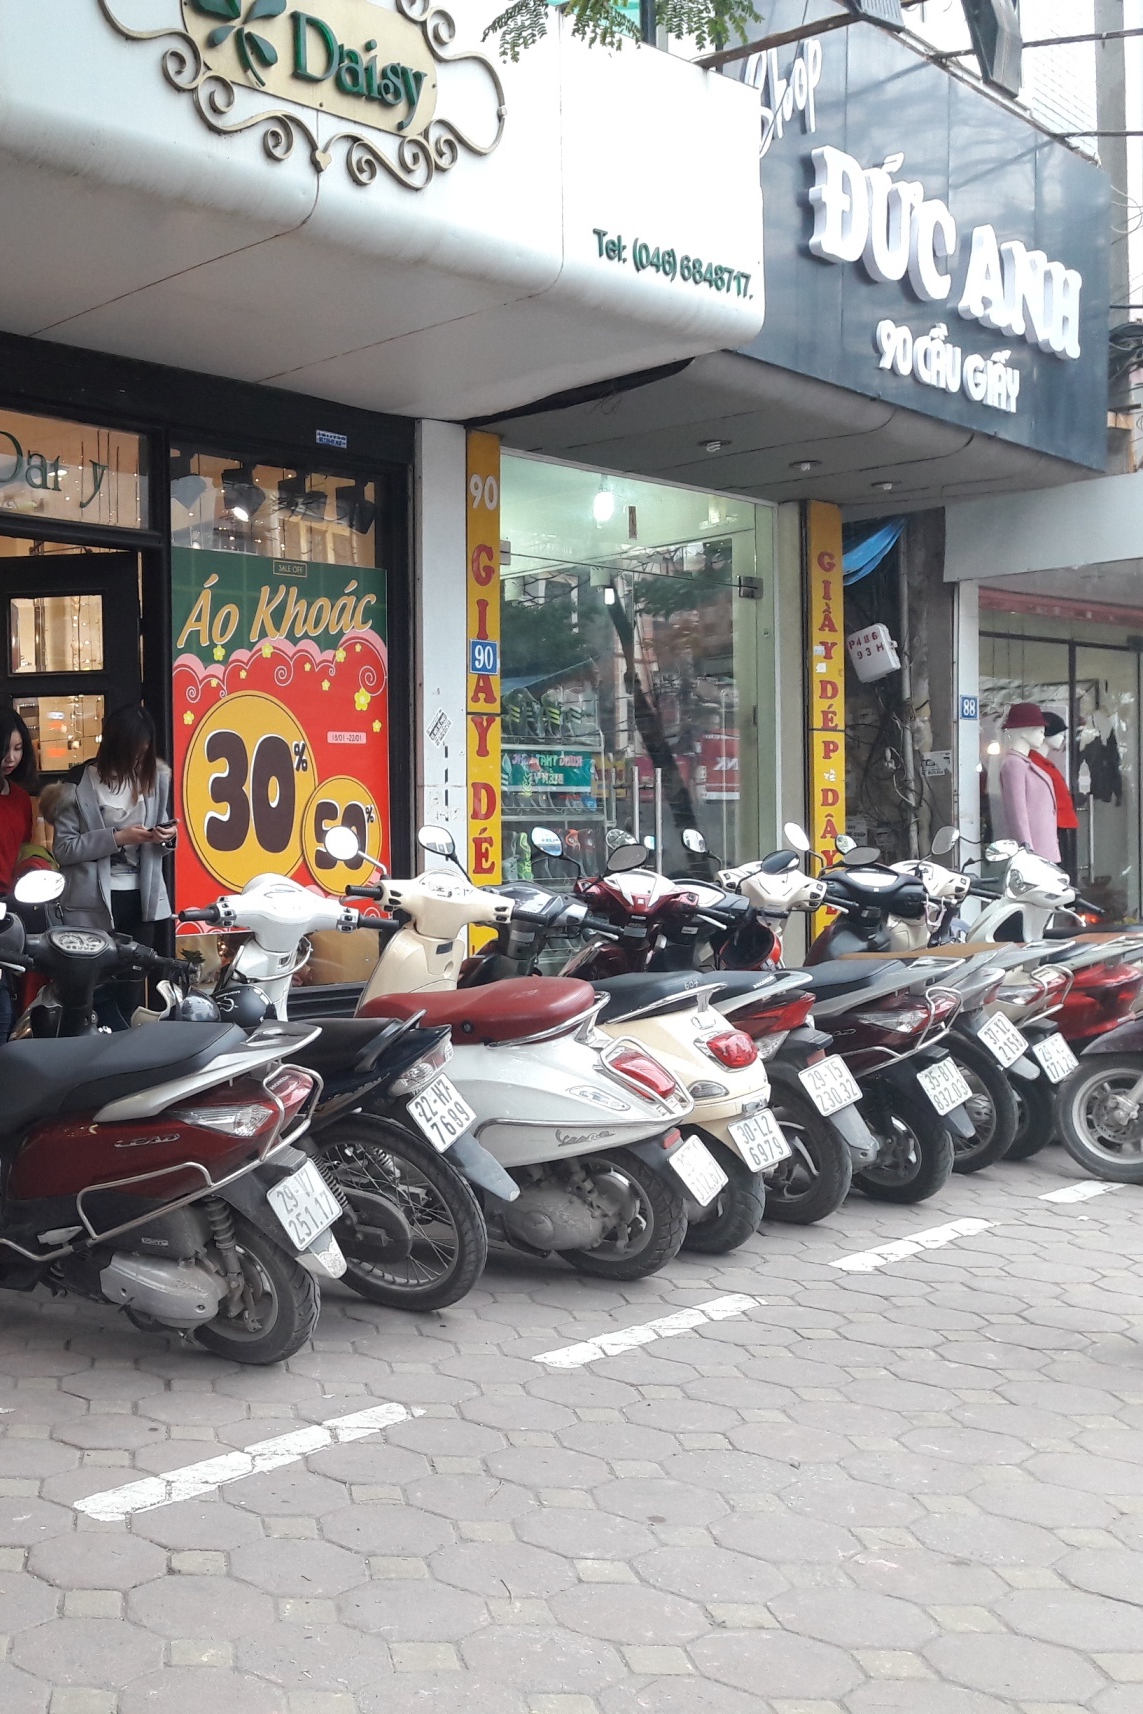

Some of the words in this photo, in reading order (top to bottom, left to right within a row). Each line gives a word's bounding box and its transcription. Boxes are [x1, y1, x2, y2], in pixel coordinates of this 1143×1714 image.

[290, 10, 428, 131] Daisy
[592, 227, 627, 264] Tel:
[632, 237, 677, 283] (046)
[958, 225, 1082, 359] ANH
[876, 319, 913, 376] 90
[469, 475, 498, 510] 90
[177, 573, 239, 649] Áo
[250, 579, 377, 643] Khoác
[474, 645, 494, 670] 90
[819, 680, 840, 760] DÉP
[963, 699, 976, 716] 88
[269, 1075, 291, 1090] HONDA
[748, 1136, 784, 1166] 6979
[289, 1190, 334, 1245] 251.17
